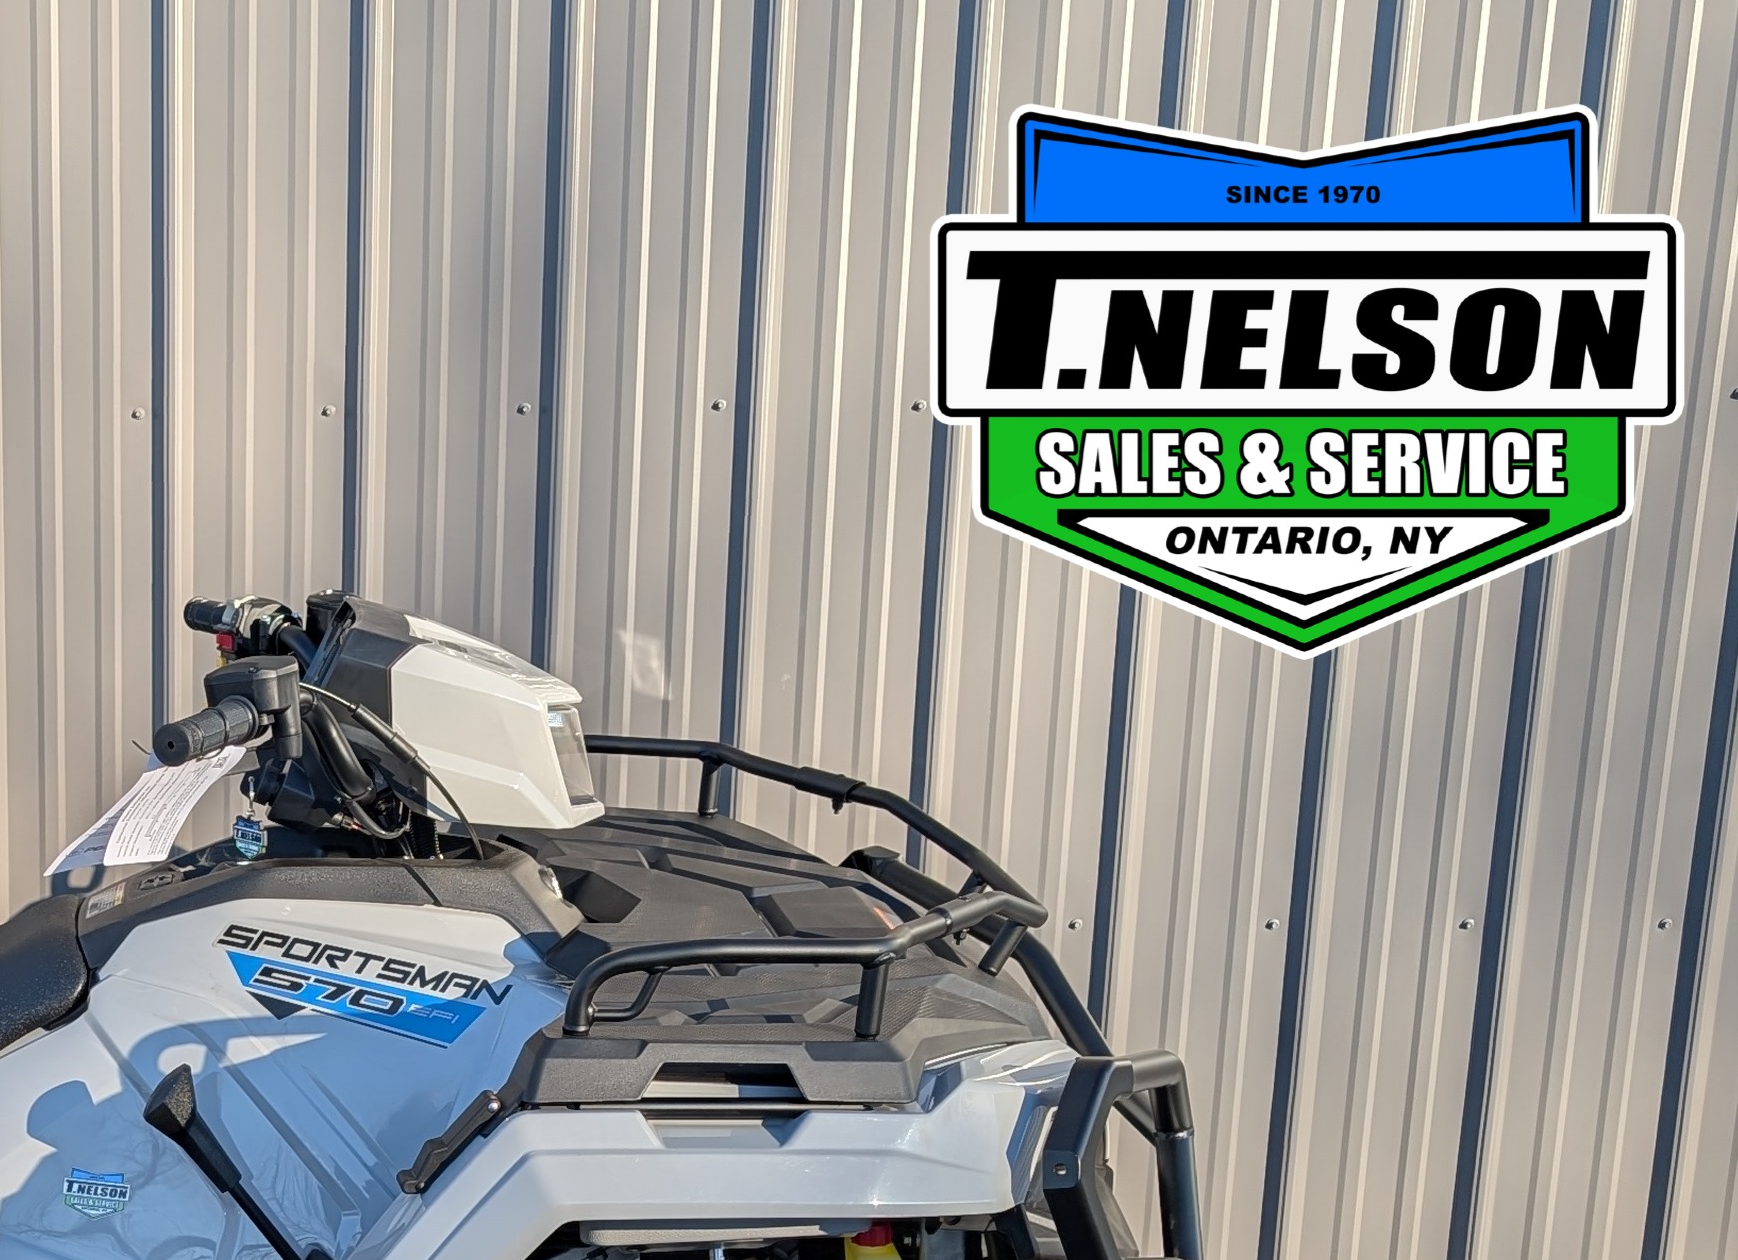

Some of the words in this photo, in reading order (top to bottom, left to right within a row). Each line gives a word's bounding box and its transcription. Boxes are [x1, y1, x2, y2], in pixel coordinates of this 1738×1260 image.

[215, 923, 514, 1006] SPORTSMAN
[251, 963, 407, 1018] 570
[407, 1003, 461, 1025] EFI
[65, 1179, 129, 1200] T.NELSON
